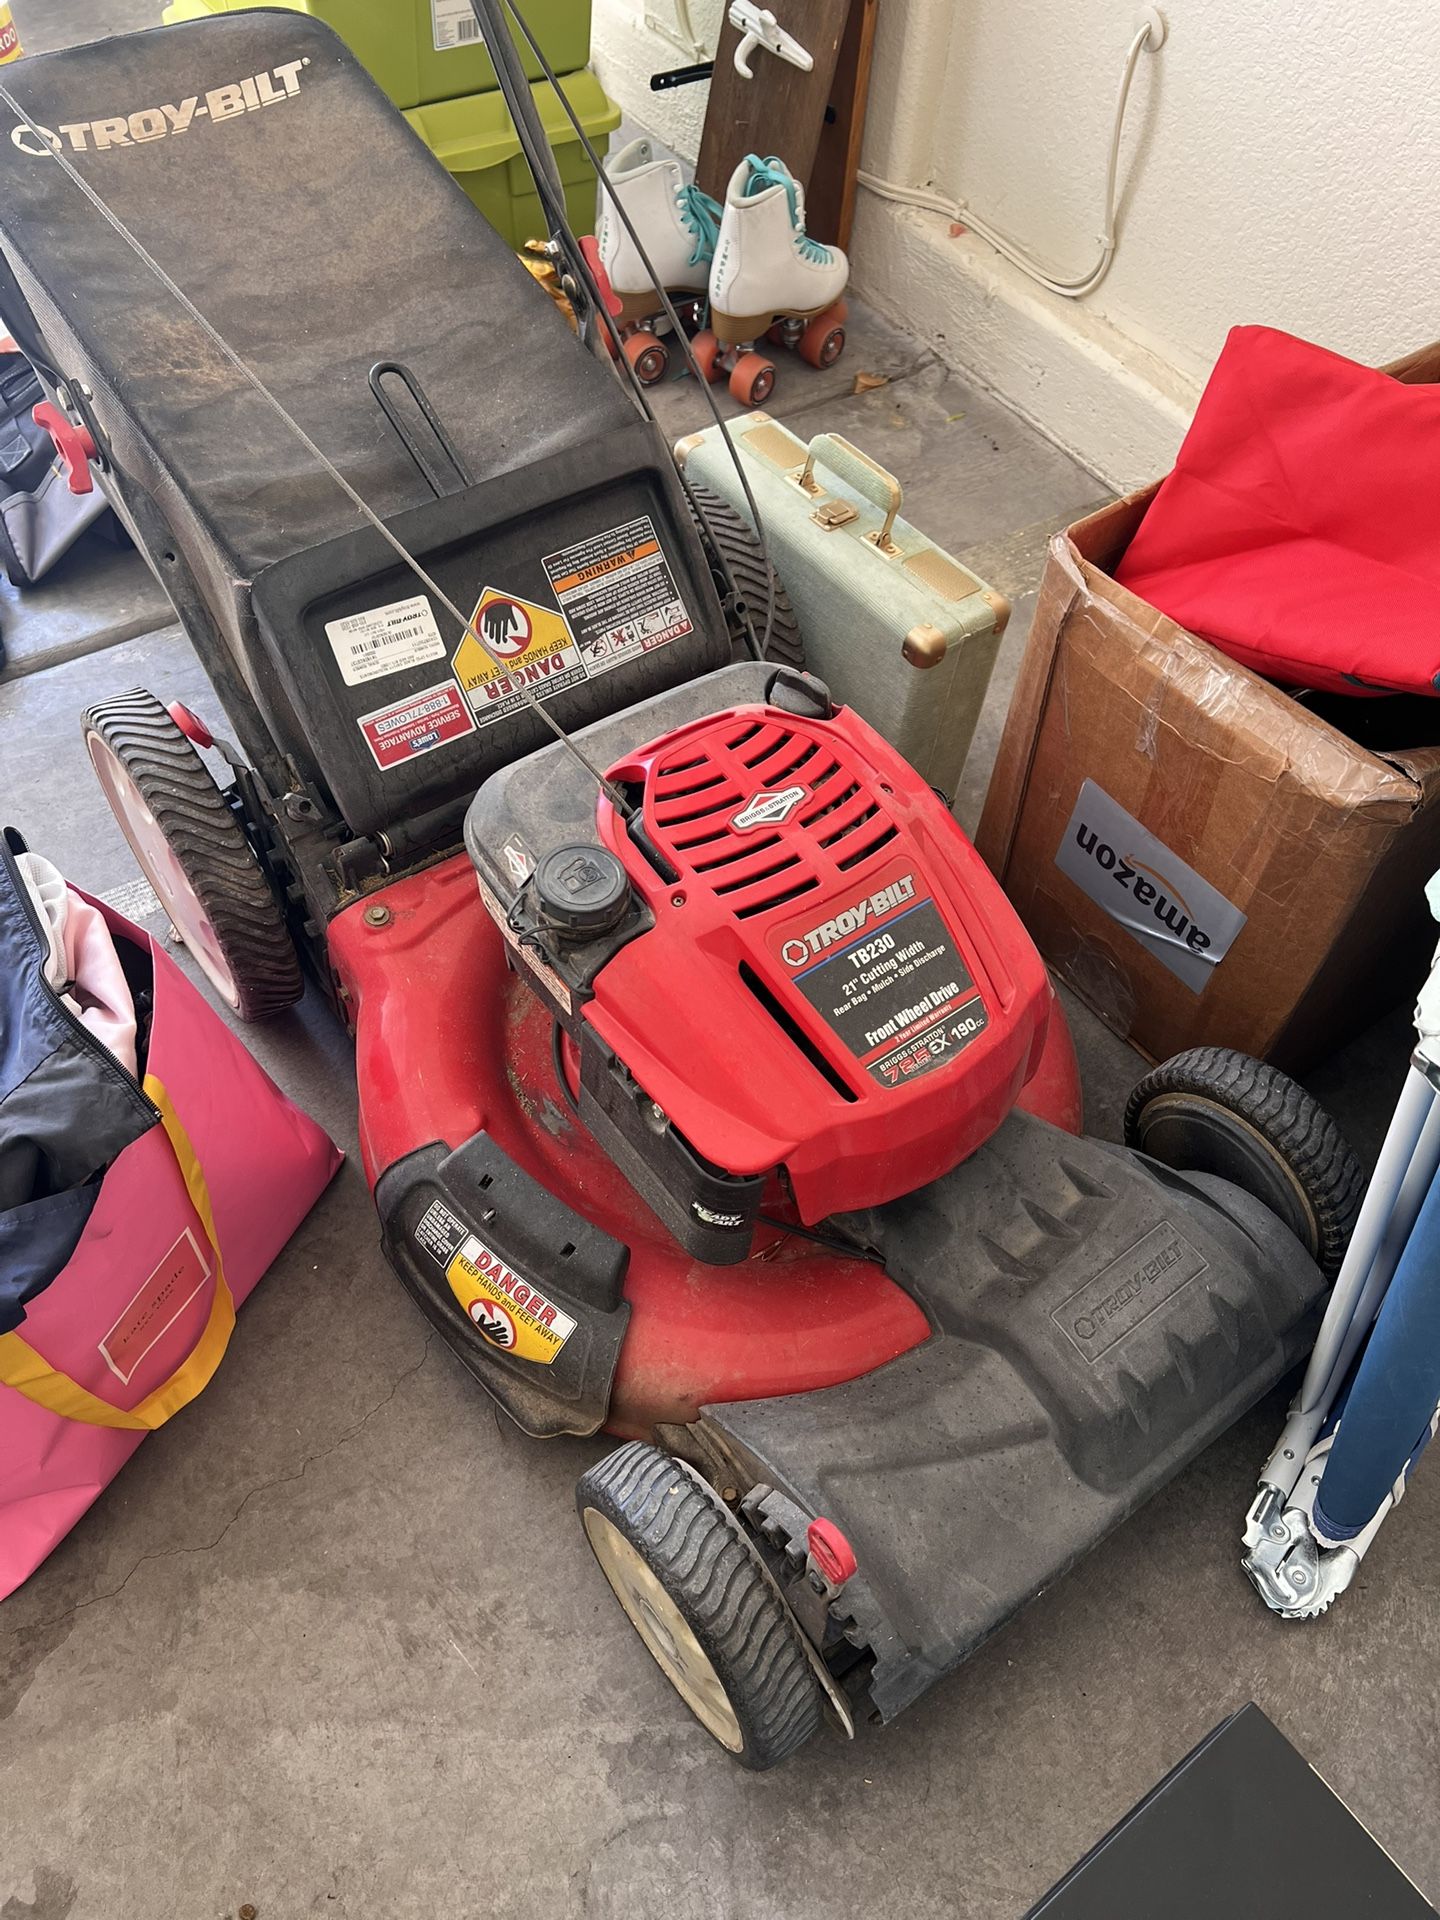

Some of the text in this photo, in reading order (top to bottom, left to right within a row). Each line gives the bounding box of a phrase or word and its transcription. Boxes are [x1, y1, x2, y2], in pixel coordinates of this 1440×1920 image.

[576, 554, 625, 581] WARNING
[522, 644, 548, 662] HANDS
[547, 636, 567, 651] KEEP
[643, 624, 680, 647] DANGER
[465, 671, 489, 688] AWAY
[483, 651, 565, 701] DANGER
[508, 656, 522, 668] and
[377, 696, 448, 732] 1-888-77LOWES
[378, 709, 460, 750] SERVICE ADVANTAGE
[410, 731, 438, 748] LOWE'S
[1075, 826, 1211, 954] amazon
[804, 874, 916, 955] TROY-BILT
[846, 931, 896, 970] TB230
[858, 955, 899, 986] Cutting
[894, 938, 926, 963] Width
[832, 943, 947, 1017] Rear Bag Mulch Side Discharge
[864, 979, 960, 1047] Front Wheel Drive
[893, 1002, 952, 1043] 2 Year Limited Warranty
[883, 1046, 932, 1084] 725
[927, 1033, 951, 1056] EX
[457, 1257, 559, 1346] KEEP HANDS and FEET AWAY
[472, 1249, 559, 1327] DANGER
[1093, 1239, 1183, 1327] TROY-BILT
